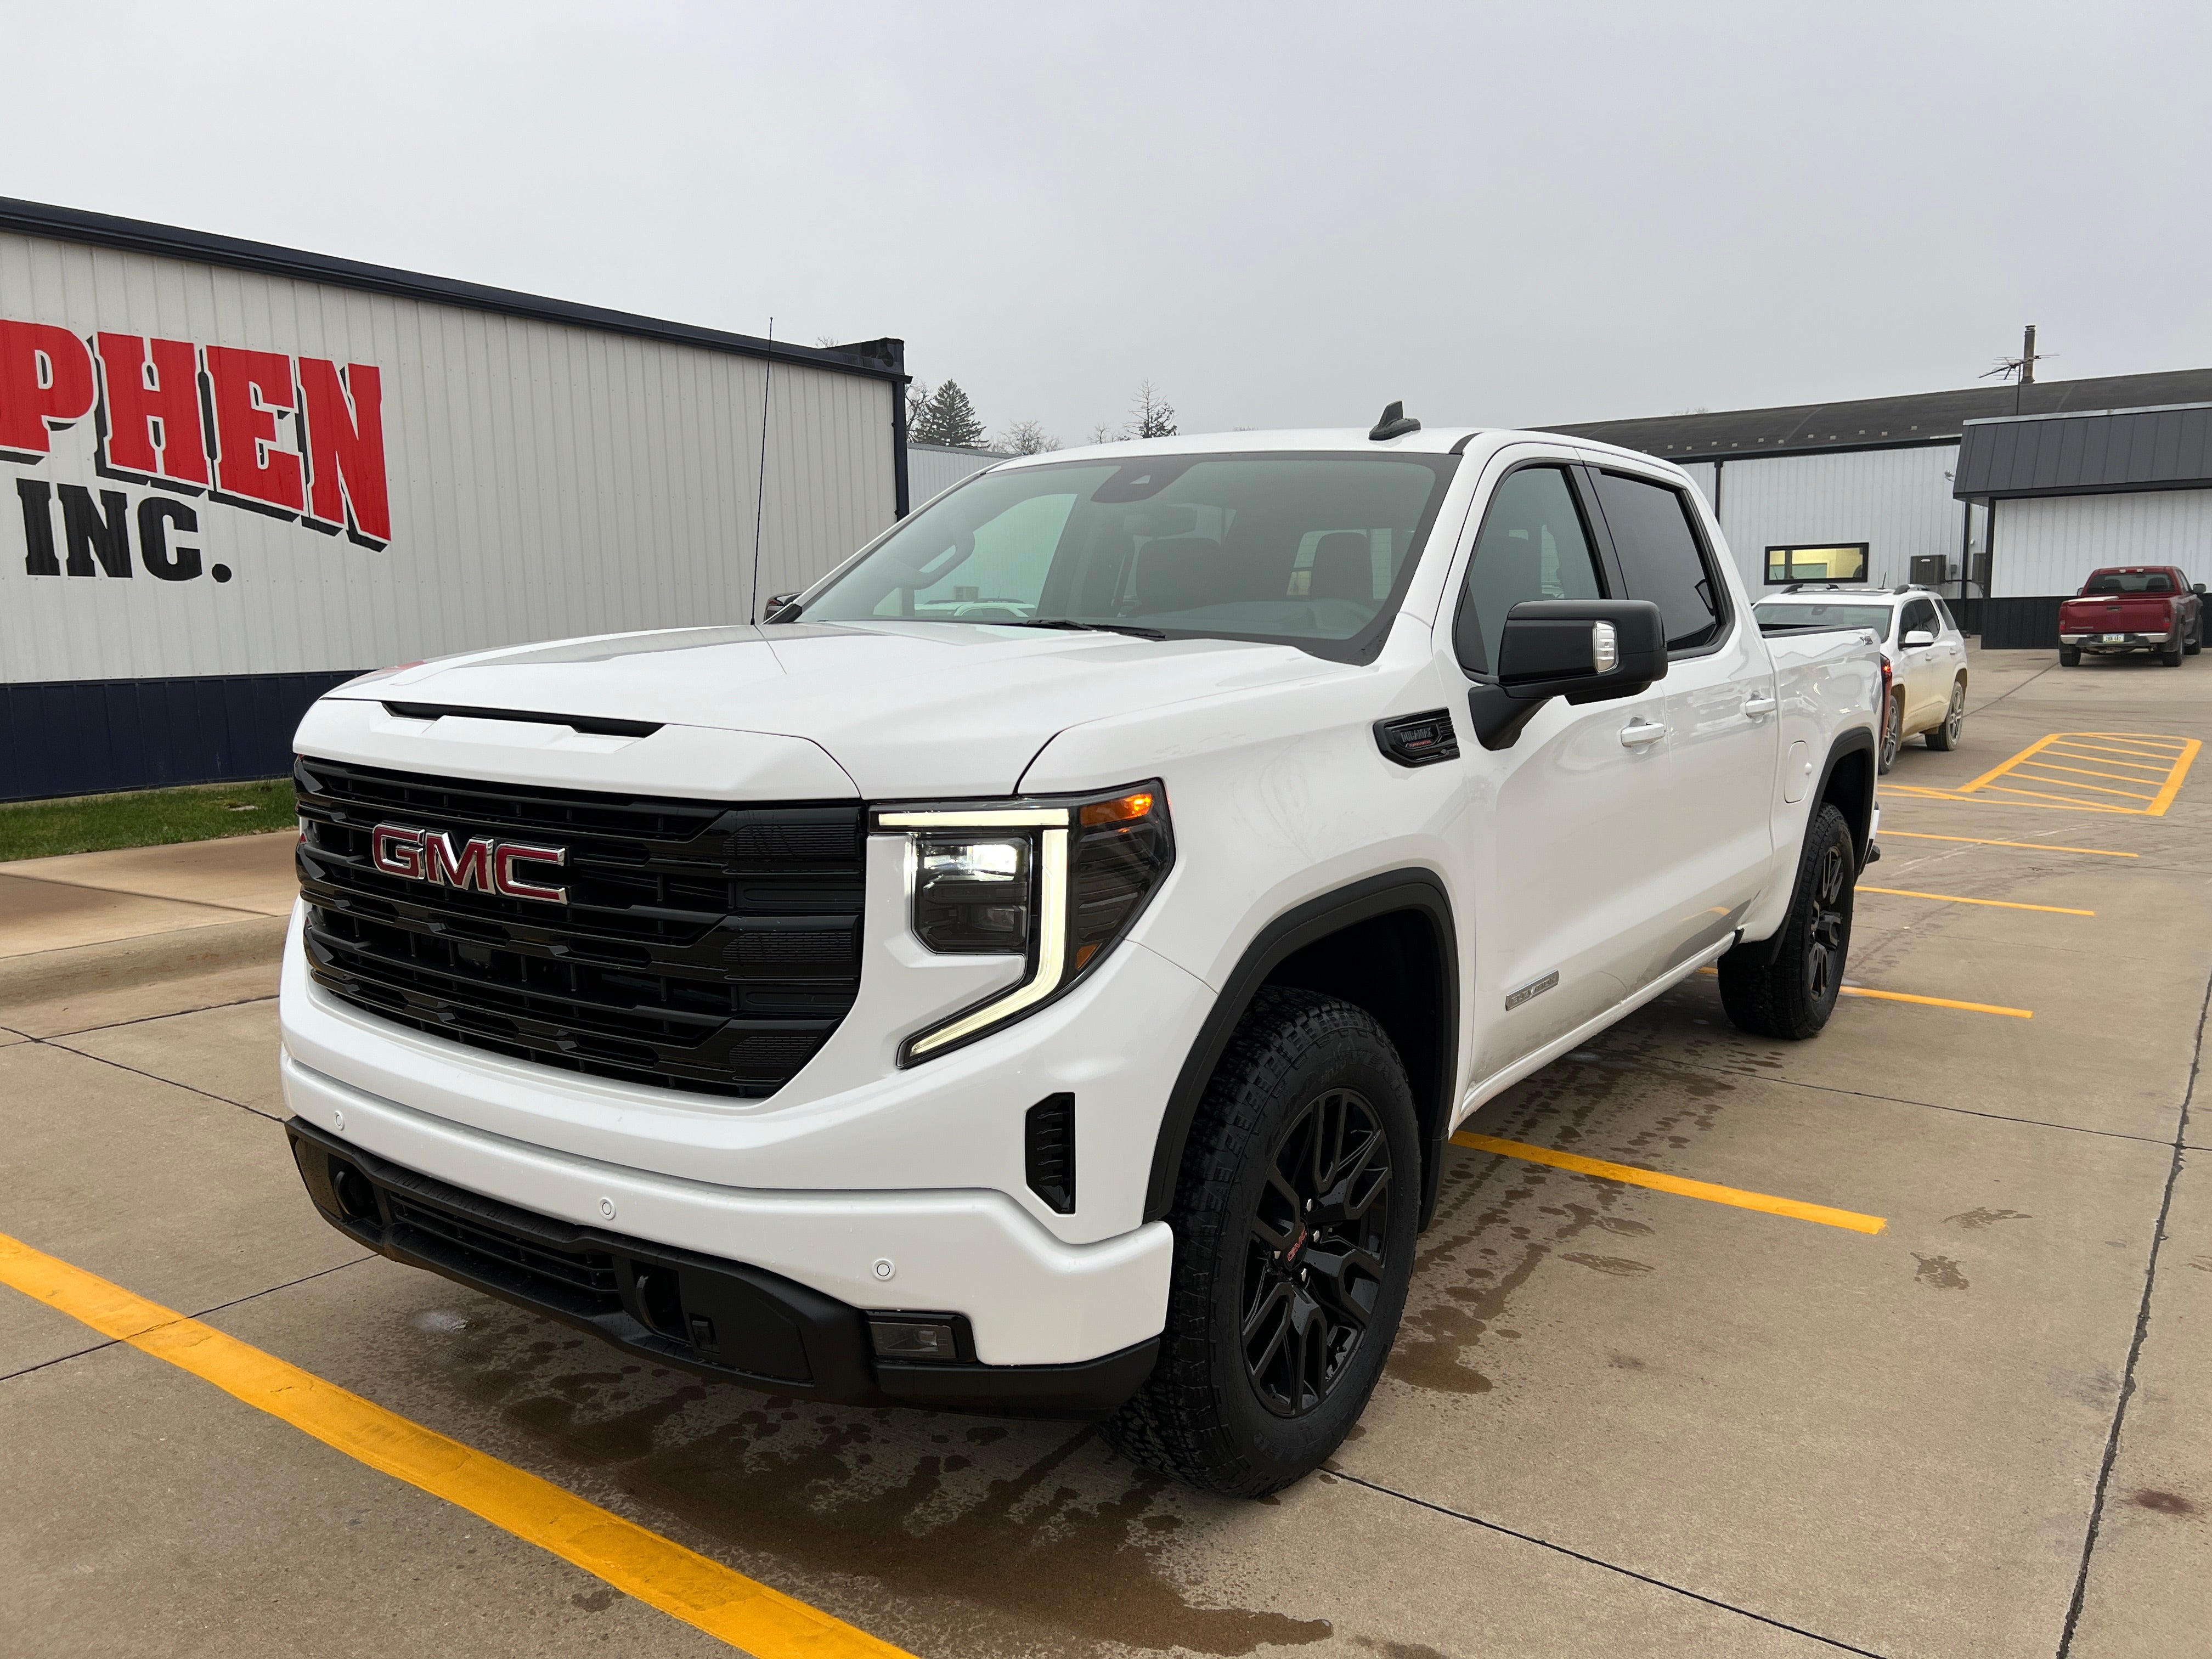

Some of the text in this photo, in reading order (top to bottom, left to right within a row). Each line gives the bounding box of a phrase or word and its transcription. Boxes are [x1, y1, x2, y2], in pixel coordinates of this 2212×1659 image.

[16, 478, 232, 583] INC.
[372, 822, 568, 905] GMC
[1287, 1225, 1307, 1261] GMC
